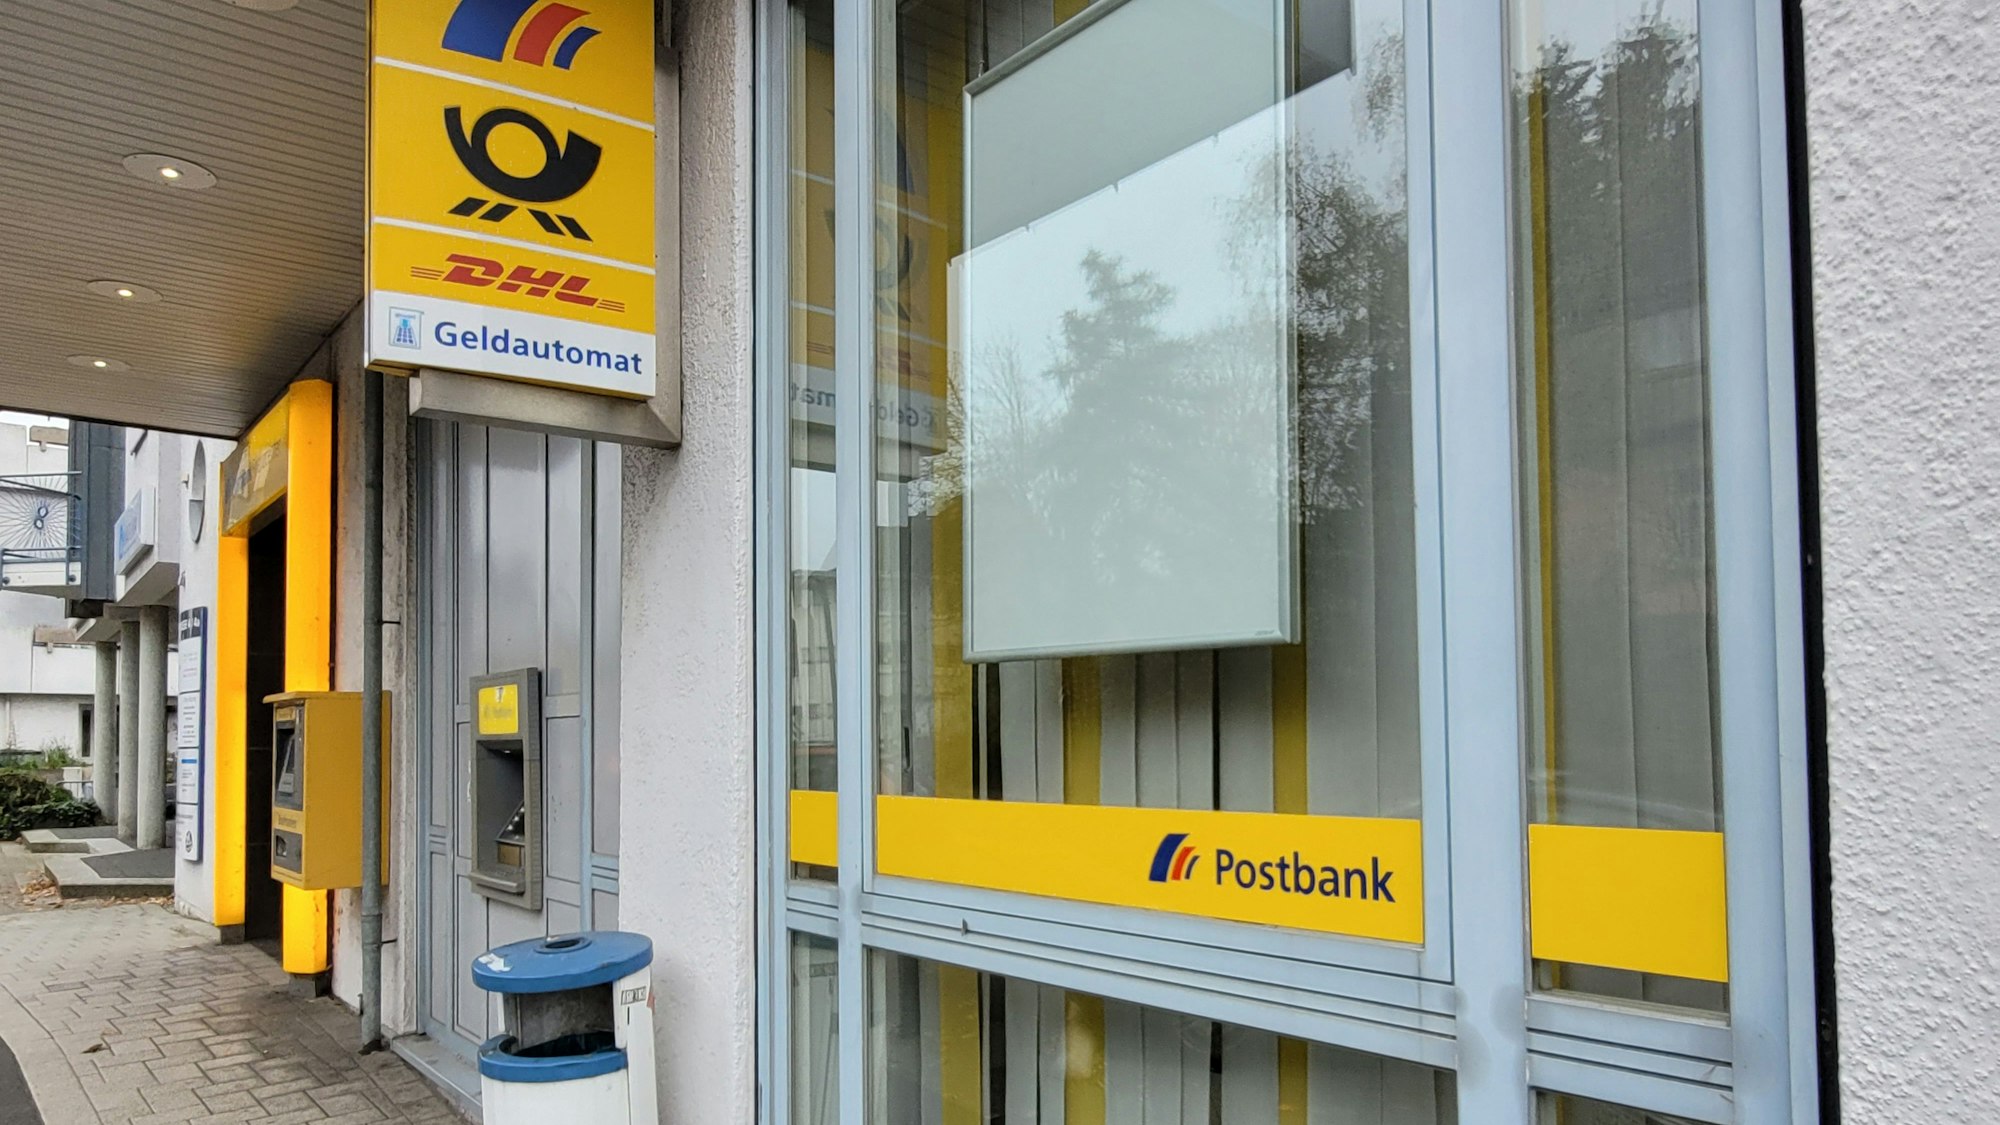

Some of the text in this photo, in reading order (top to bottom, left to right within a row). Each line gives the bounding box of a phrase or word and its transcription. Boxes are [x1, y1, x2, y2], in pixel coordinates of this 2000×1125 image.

[442, 253, 599, 307] DHL
[434, 321, 642, 375] Geldautomat
[1216, 848, 1396, 903] Postbank
